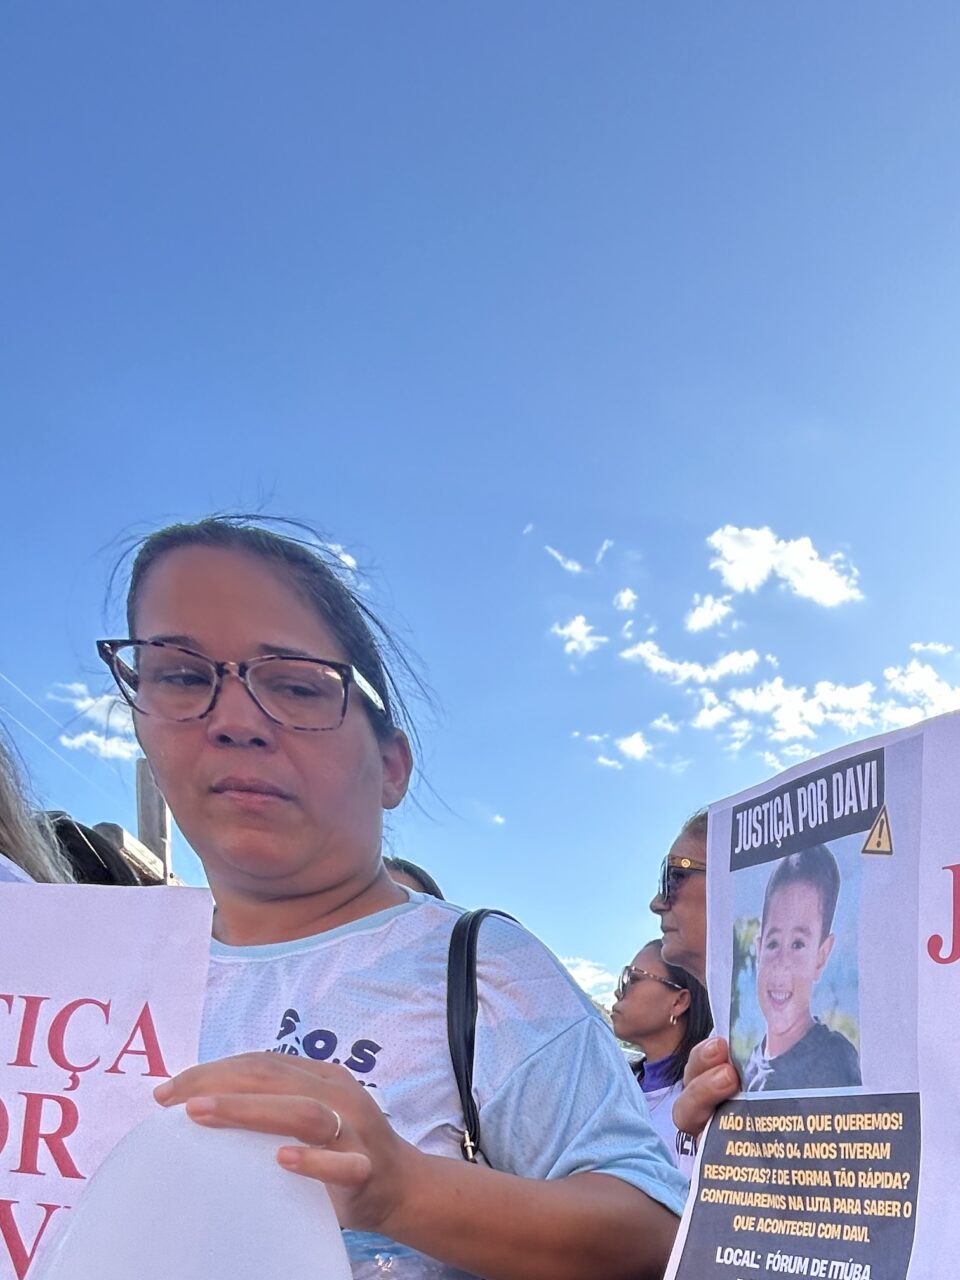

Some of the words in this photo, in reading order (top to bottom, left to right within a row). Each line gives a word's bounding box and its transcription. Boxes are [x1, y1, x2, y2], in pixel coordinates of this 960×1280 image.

[734, 792, 794, 854] JUSTIÇA
[797, 777, 829, 832] POR
[832, 760, 878, 820] DAVI
[719, 1112, 743, 1130] NÃO
[755, 1115, 805, 1132] RESPOSTA
[806, 1114, 832, 1134] QUE
[834, 1112, 903, 1133] QUEREMOS!
[786, 1143, 801, 1159] 04
[803, 1142, 837, 1159] ANOS
[838, 1142, 891, 1159] TIVERAM
[703, 1163, 771, 1184] RESPOSTAS?
[777, 1169, 790, 1185] DE
[791, 1169, 832, 1187] FORMA
[833, 1167, 856, 1188] TÃO
[858, 1167, 911, 1190] RÁPIDA?
[700, 1188, 787, 1211] CONTINUAREMOS
[788, 1195, 805, 1212] NA
[805, 1196, 831, 1213] LUTA
[833, 1197, 862, 1215] PARA
[863, 1199, 901, 1218] SABER
[903, 1201, 912, 1218] O
[733, 1214, 756, 1232] QUE
[756, 1217, 816, 1238] ACONTECEU
[817, 1222, 842, 1240] COM
[842, 1224, 871, 1243] DAVI.
[715, 1246, 762, 1269] LOCAL:
[765, 1250, 809, 1277] FÓRUM
[810, 1257, 829, 1279] DE
